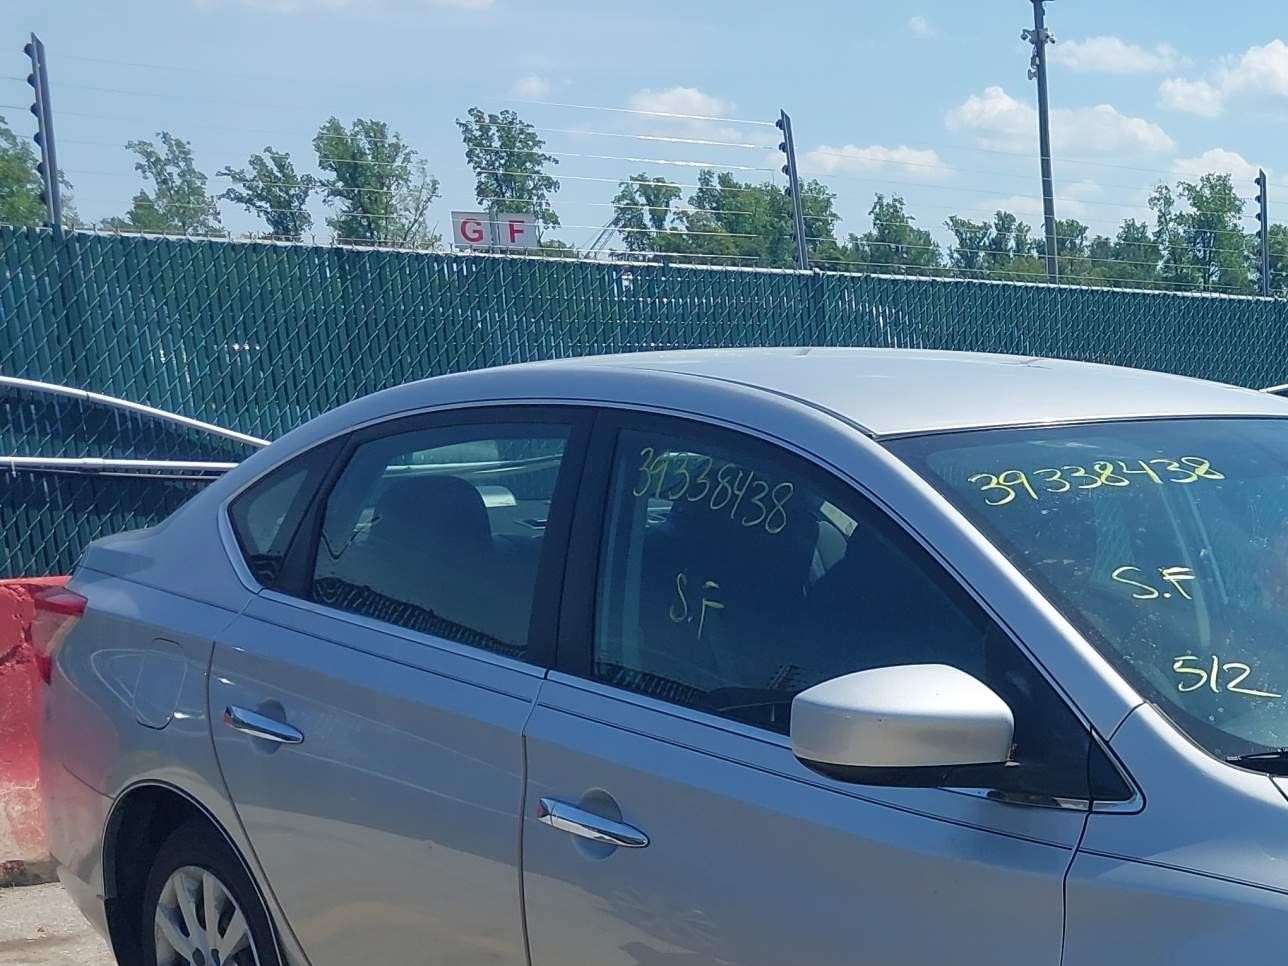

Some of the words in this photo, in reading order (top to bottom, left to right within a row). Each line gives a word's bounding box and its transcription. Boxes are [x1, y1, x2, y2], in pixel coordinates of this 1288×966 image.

[460, 218, 484, 243] G
[508, 220, 525, 243] F
[633, 447, 794, 534] 39338438
[967, 456, 1226, 506] 39338438
[1111, 565, 1196, 600] S.F
[1172, 655, 1282, 698] 512
